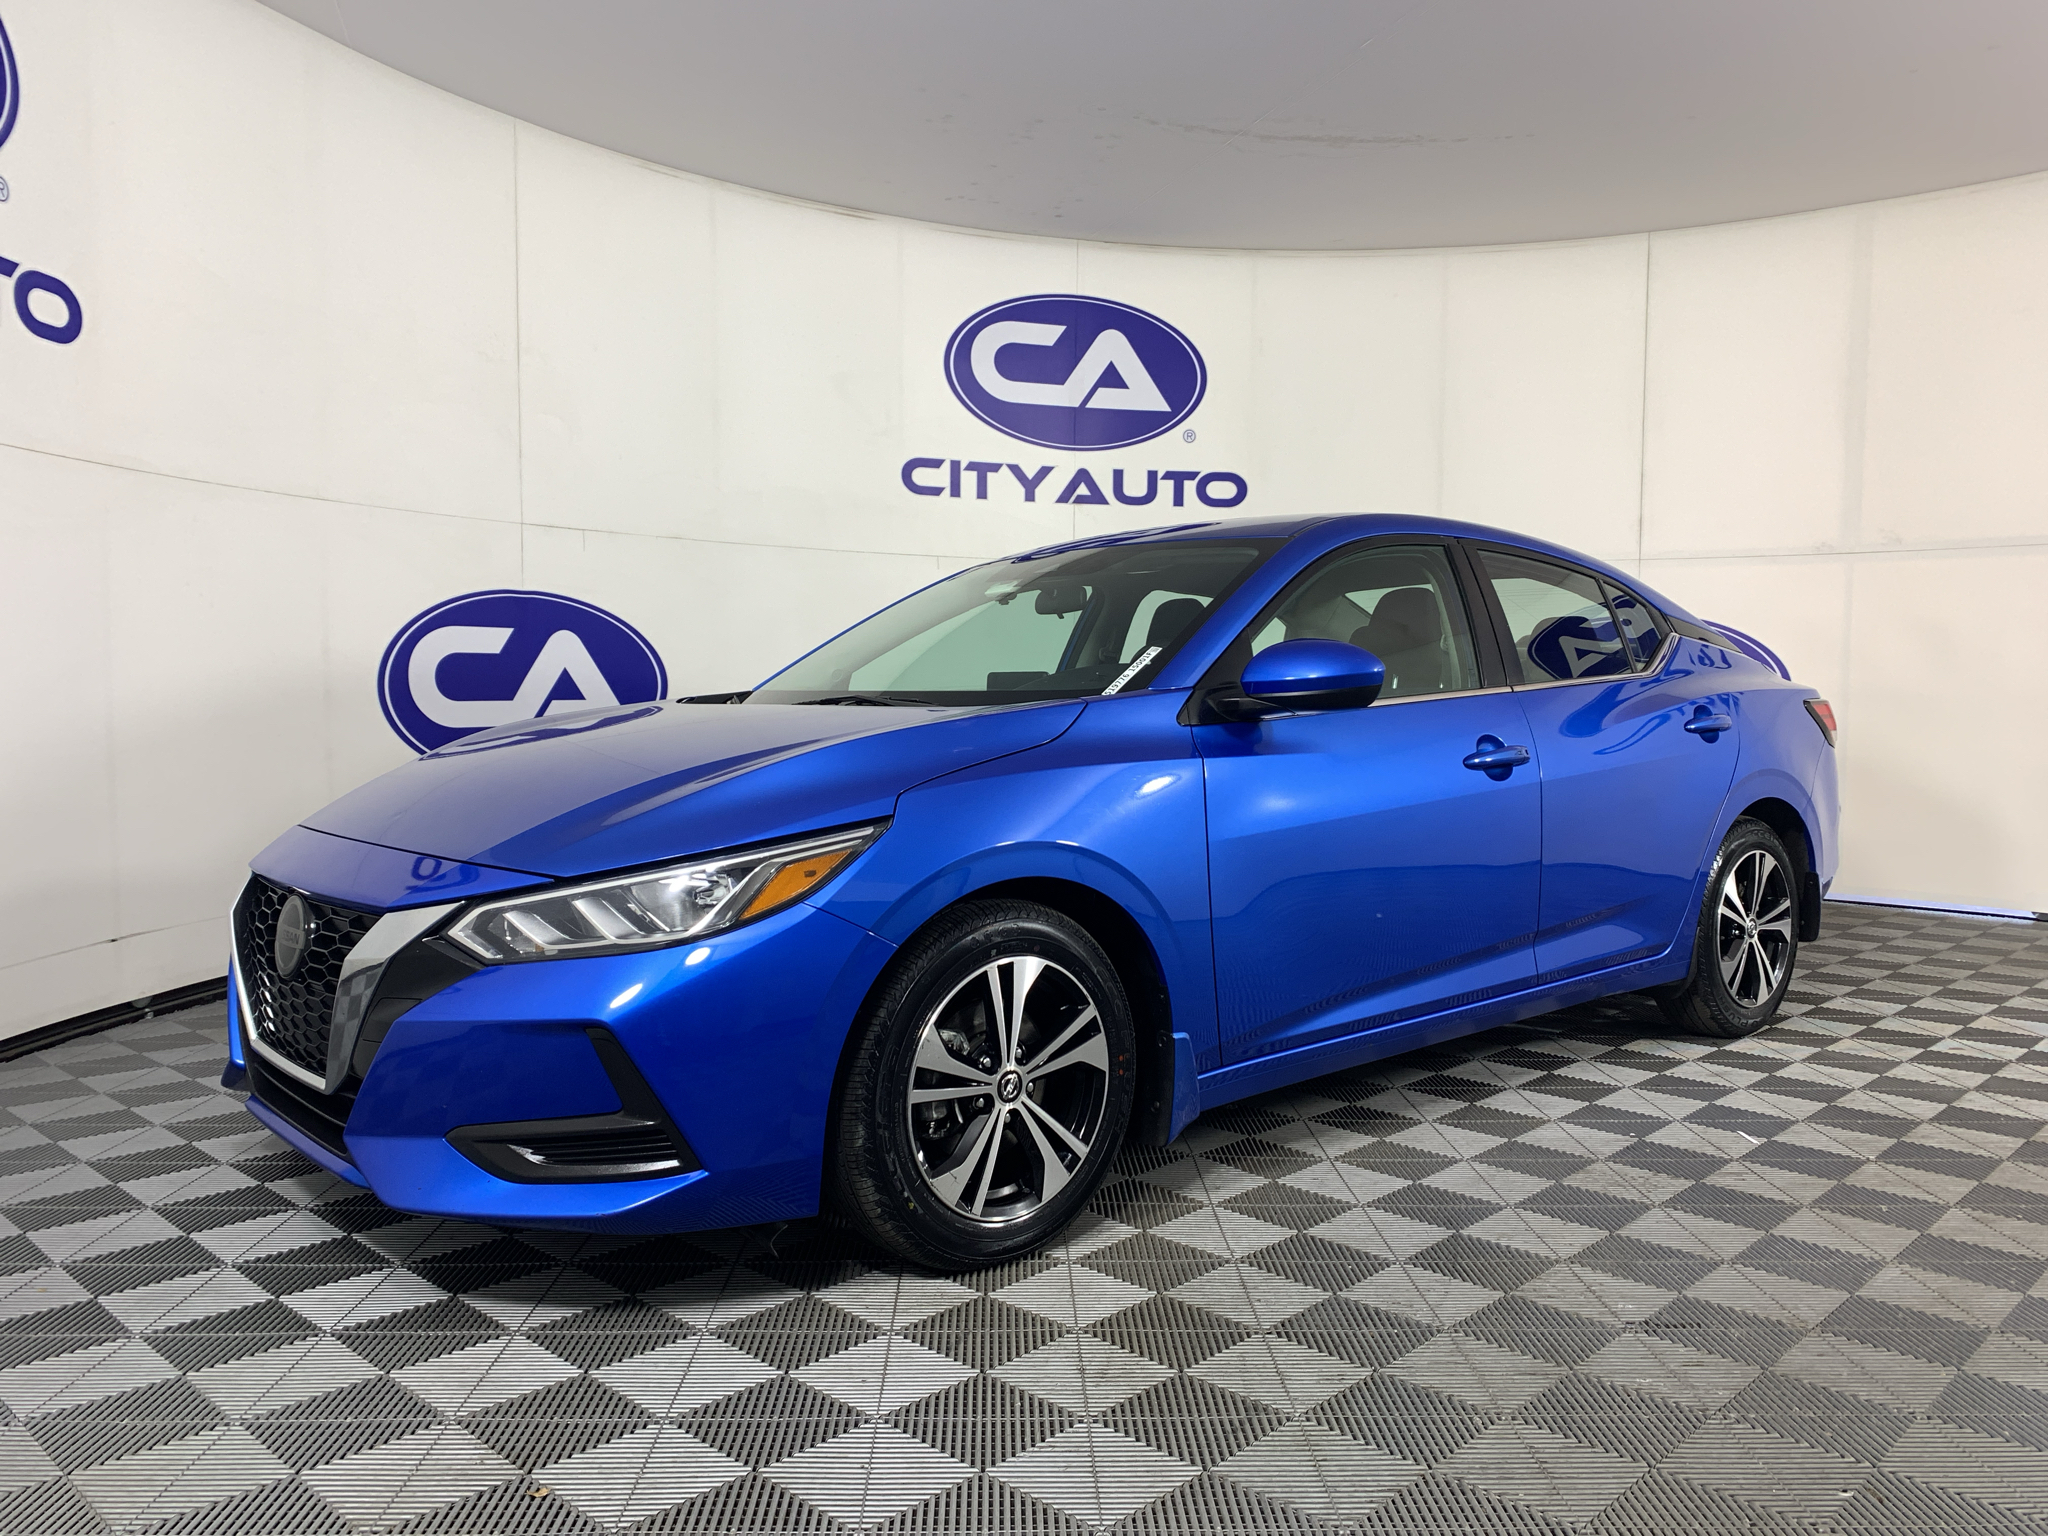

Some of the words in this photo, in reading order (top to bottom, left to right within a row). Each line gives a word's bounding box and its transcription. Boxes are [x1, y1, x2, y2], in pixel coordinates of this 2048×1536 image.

[970, 320, 1172, 412] CA
[901, 457, 1056, 502] CITY
[1054, 468, 1248, 508] AUTO
[408, 625, 621, 728] CA
